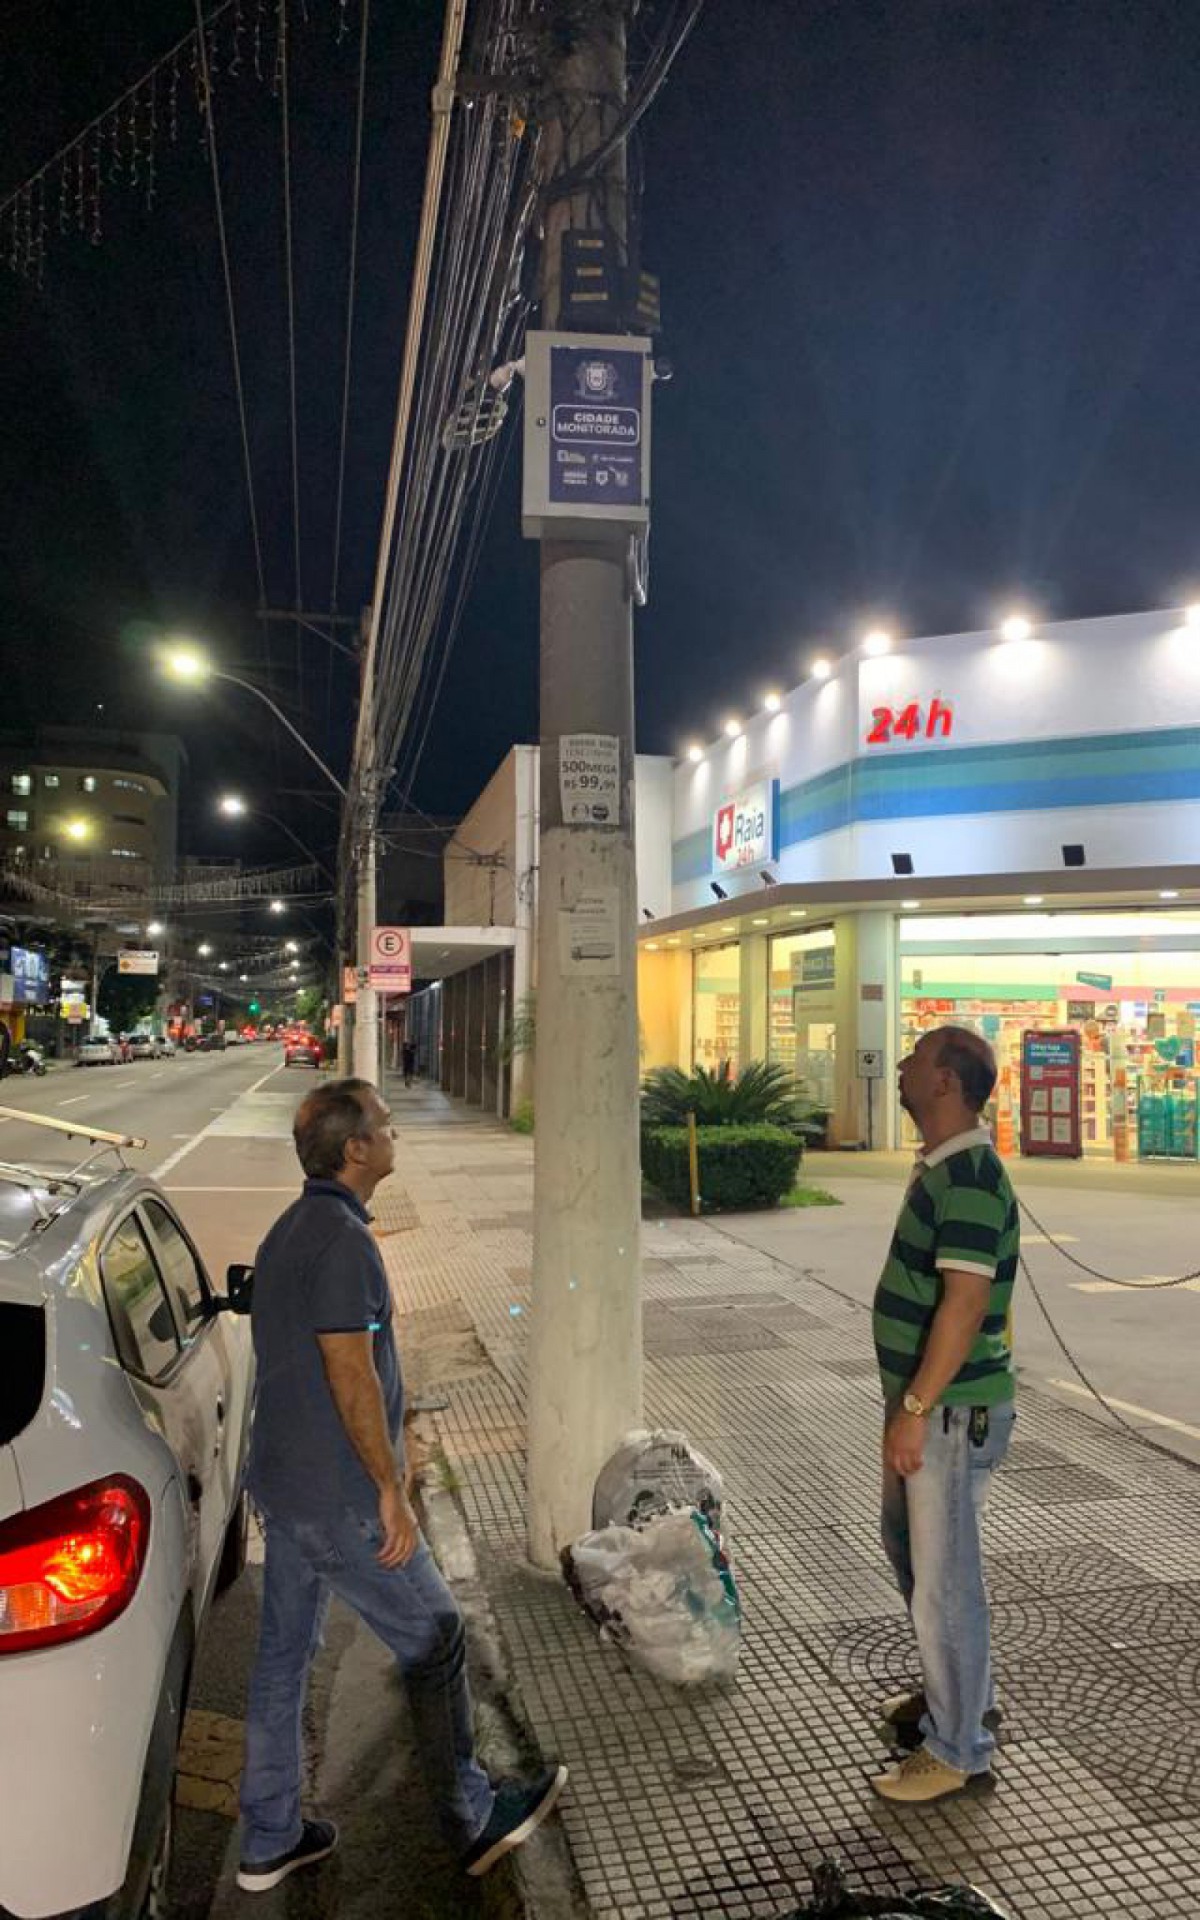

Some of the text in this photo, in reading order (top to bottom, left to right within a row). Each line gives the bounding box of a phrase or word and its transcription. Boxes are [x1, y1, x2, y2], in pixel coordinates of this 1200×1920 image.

[573, 412, 620, 425] CIDADE
[557, 423, 636, 436] MONITORADA
[735, 808, 764, 847] Raia
[385, 936, 395, 952] E
